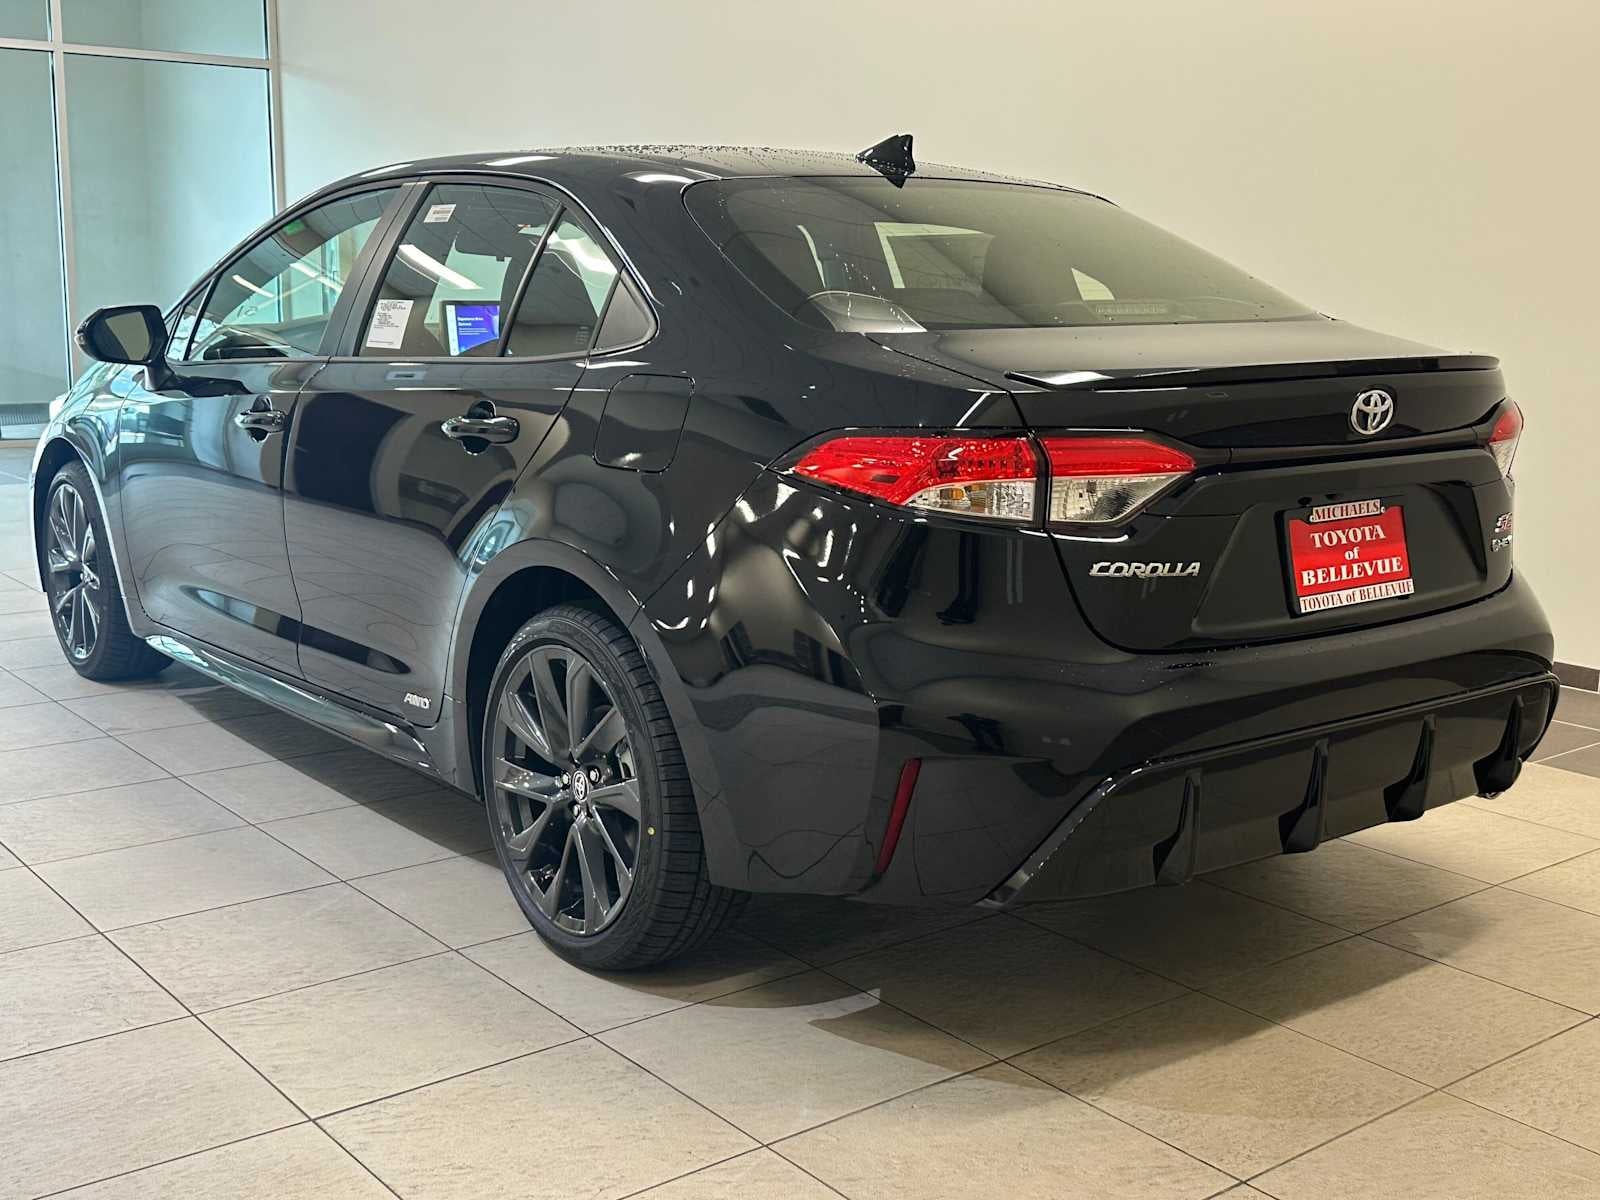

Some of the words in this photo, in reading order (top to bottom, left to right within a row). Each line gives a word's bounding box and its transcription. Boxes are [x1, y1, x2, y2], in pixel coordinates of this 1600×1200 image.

[1314, 501, 1379, 521] MICHAELS
[1310, 525, 1386, 548] TOYOTA
[1344, 547, 1360, 560] of
[1089, 562, 1200, 578] COROLLA
[1301, 557, 1403, 587] BELLEVUE
[1301, 593, 1344, 611] TOYOTA
[1346, 590, 1357, 603] of
[1360, 581, 1413, 601] BELLEVUE
[403, 693, 430, 709] AWD
